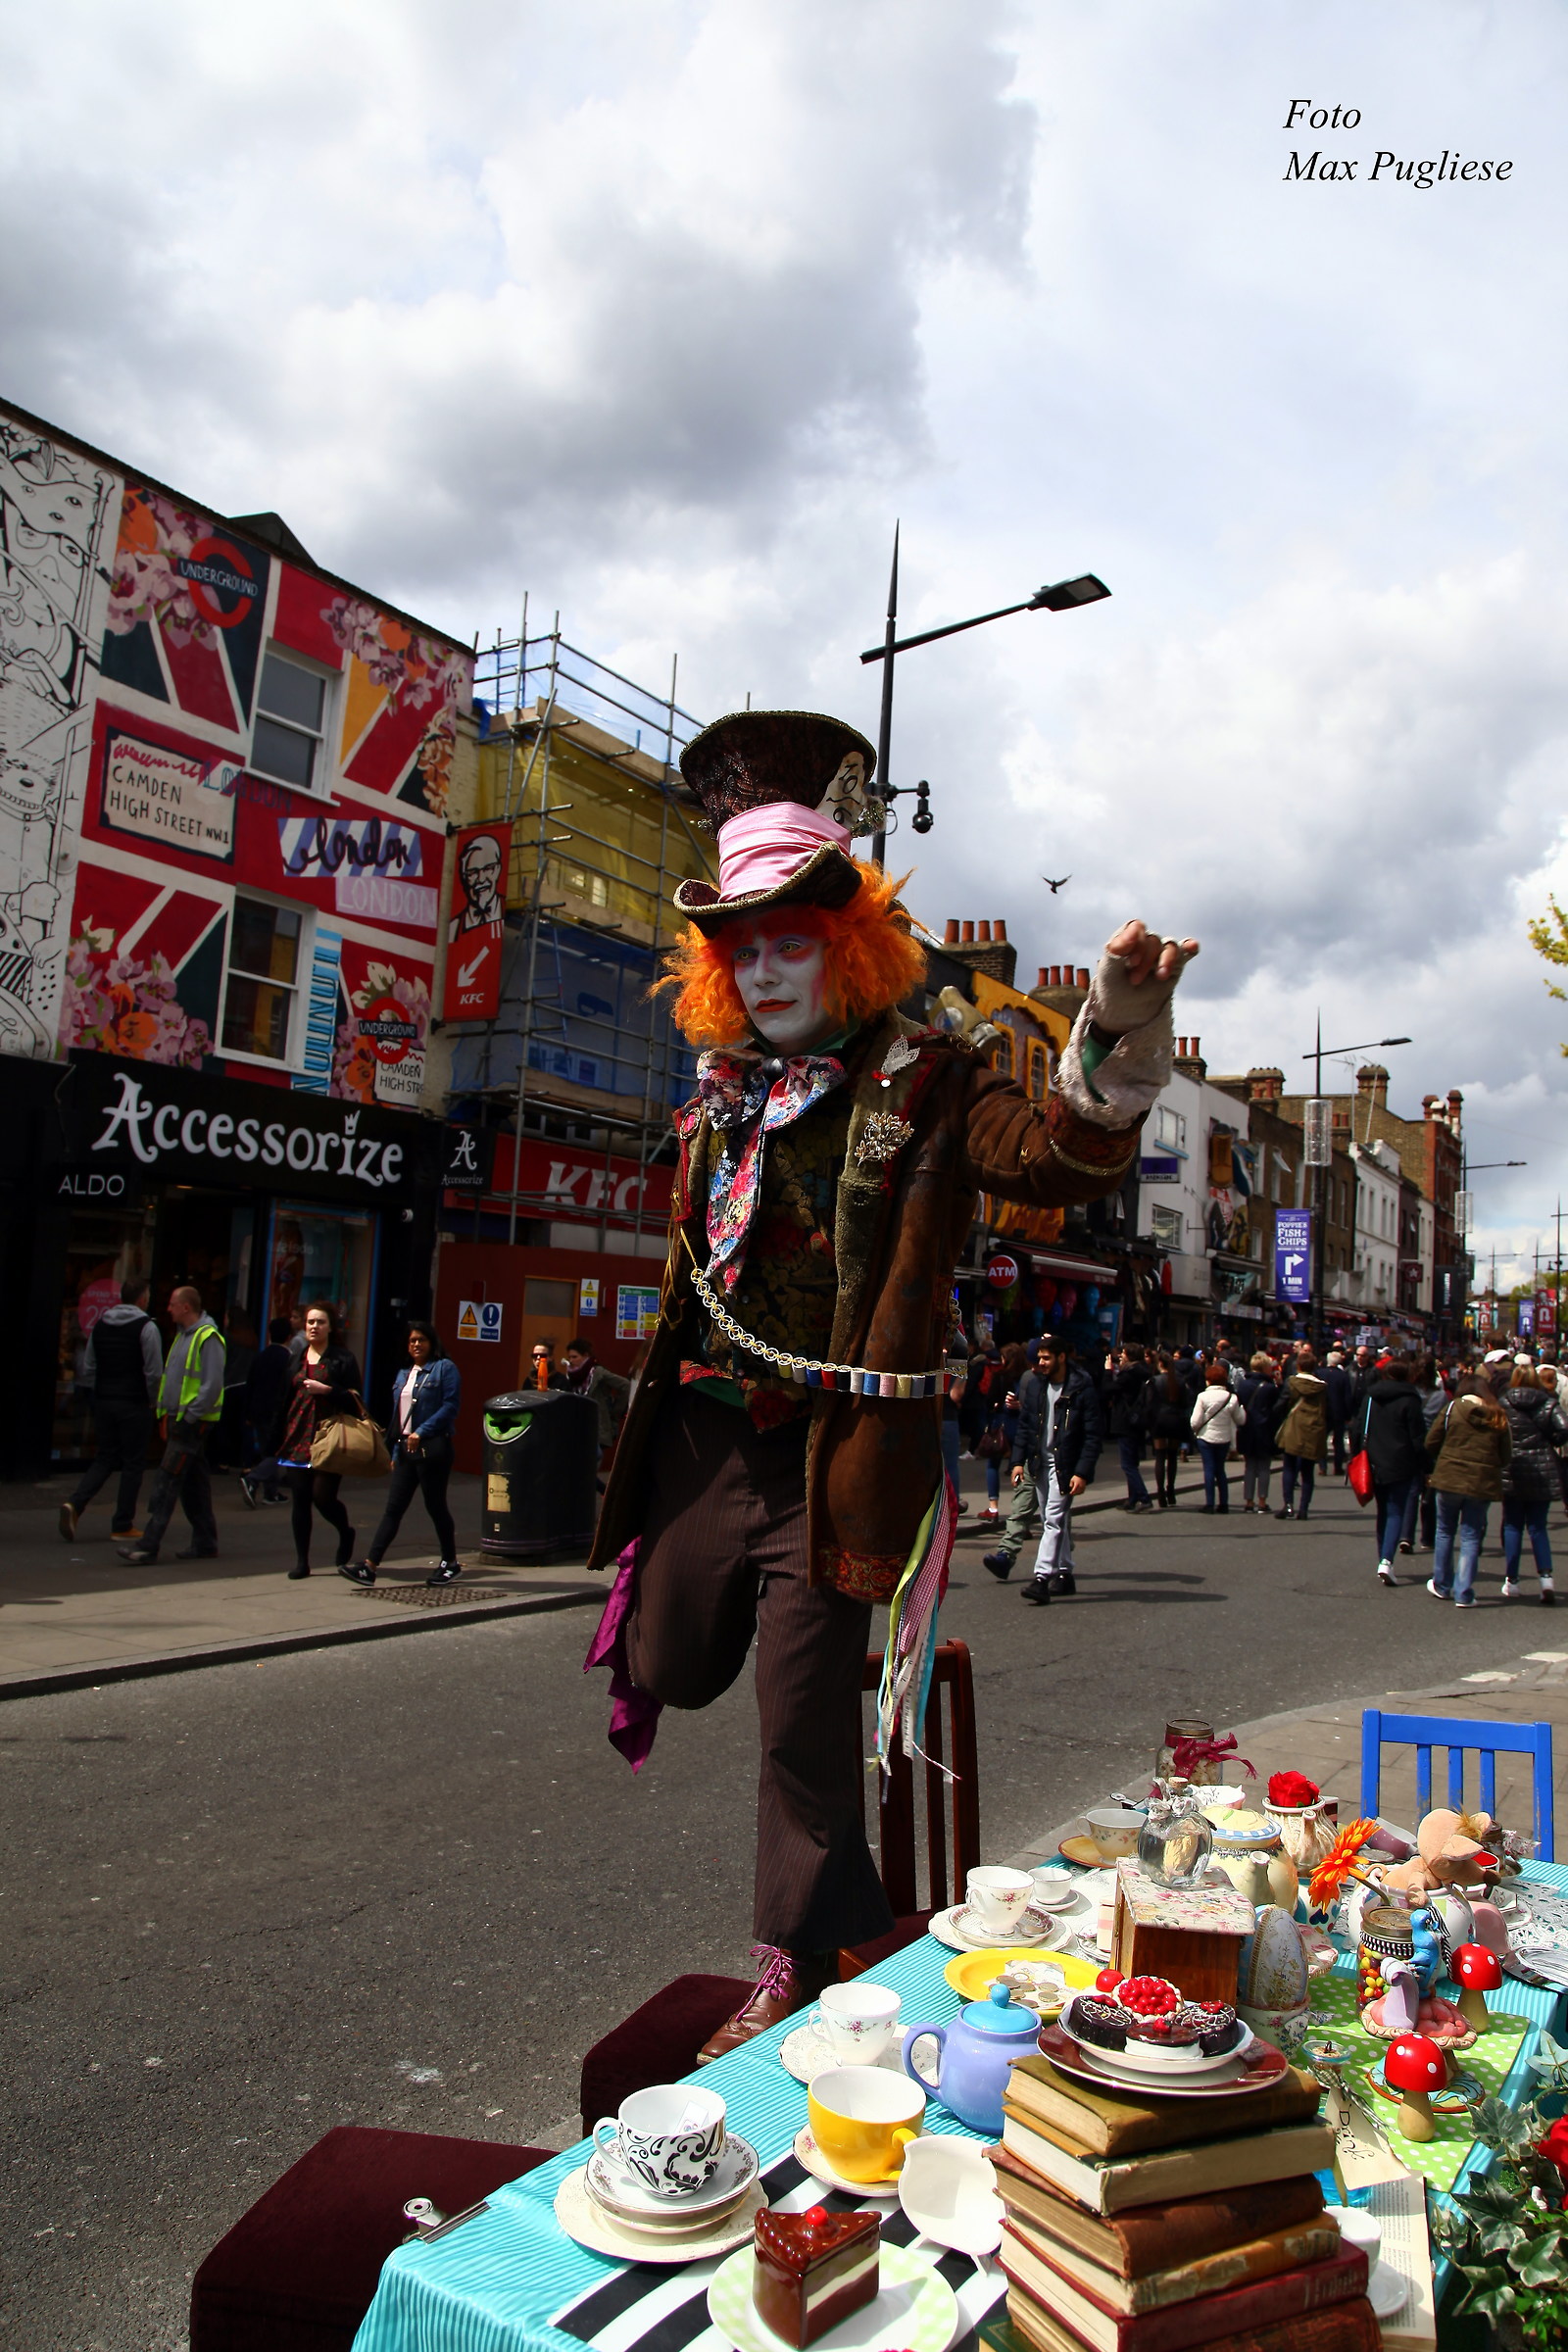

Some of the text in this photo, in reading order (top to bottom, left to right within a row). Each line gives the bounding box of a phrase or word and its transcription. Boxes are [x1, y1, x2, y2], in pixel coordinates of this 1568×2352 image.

[179, 561, 259, 597] UNDERGROUND
[113, 765, 182, 805] CAMDEN
[111, 790, 229, 845] HIGH STREET NW1
[281, 815, 412, 874] london
[338, 877, 438, 925] LONDON
[460, 992, 485, 1004] KFC
[360, 1022, 416, 1038] UNDERGROUND
[380, 1061, 421, 1079] CAMDEN
[379, 1075, 405, 1091] HIGH
[90, 1072, 404, 1187] Accessorize
[450, 1130, 478, 1171] A
[58, 1173, 125, 1196] ALDO
[441, 1174, 484, 1187] Accessorize
[539, 1160, 648, 1222] KFC
[1277, 1228, 1301, 1237] FISH
[1277, 1237, 1307, 1246] CHIPS
[987, 1266, 1015, 1278] ATM
[1282, 1276, 1302, 1285] 1 MIN
[1339, 2103, 1375, 2161] Drink
